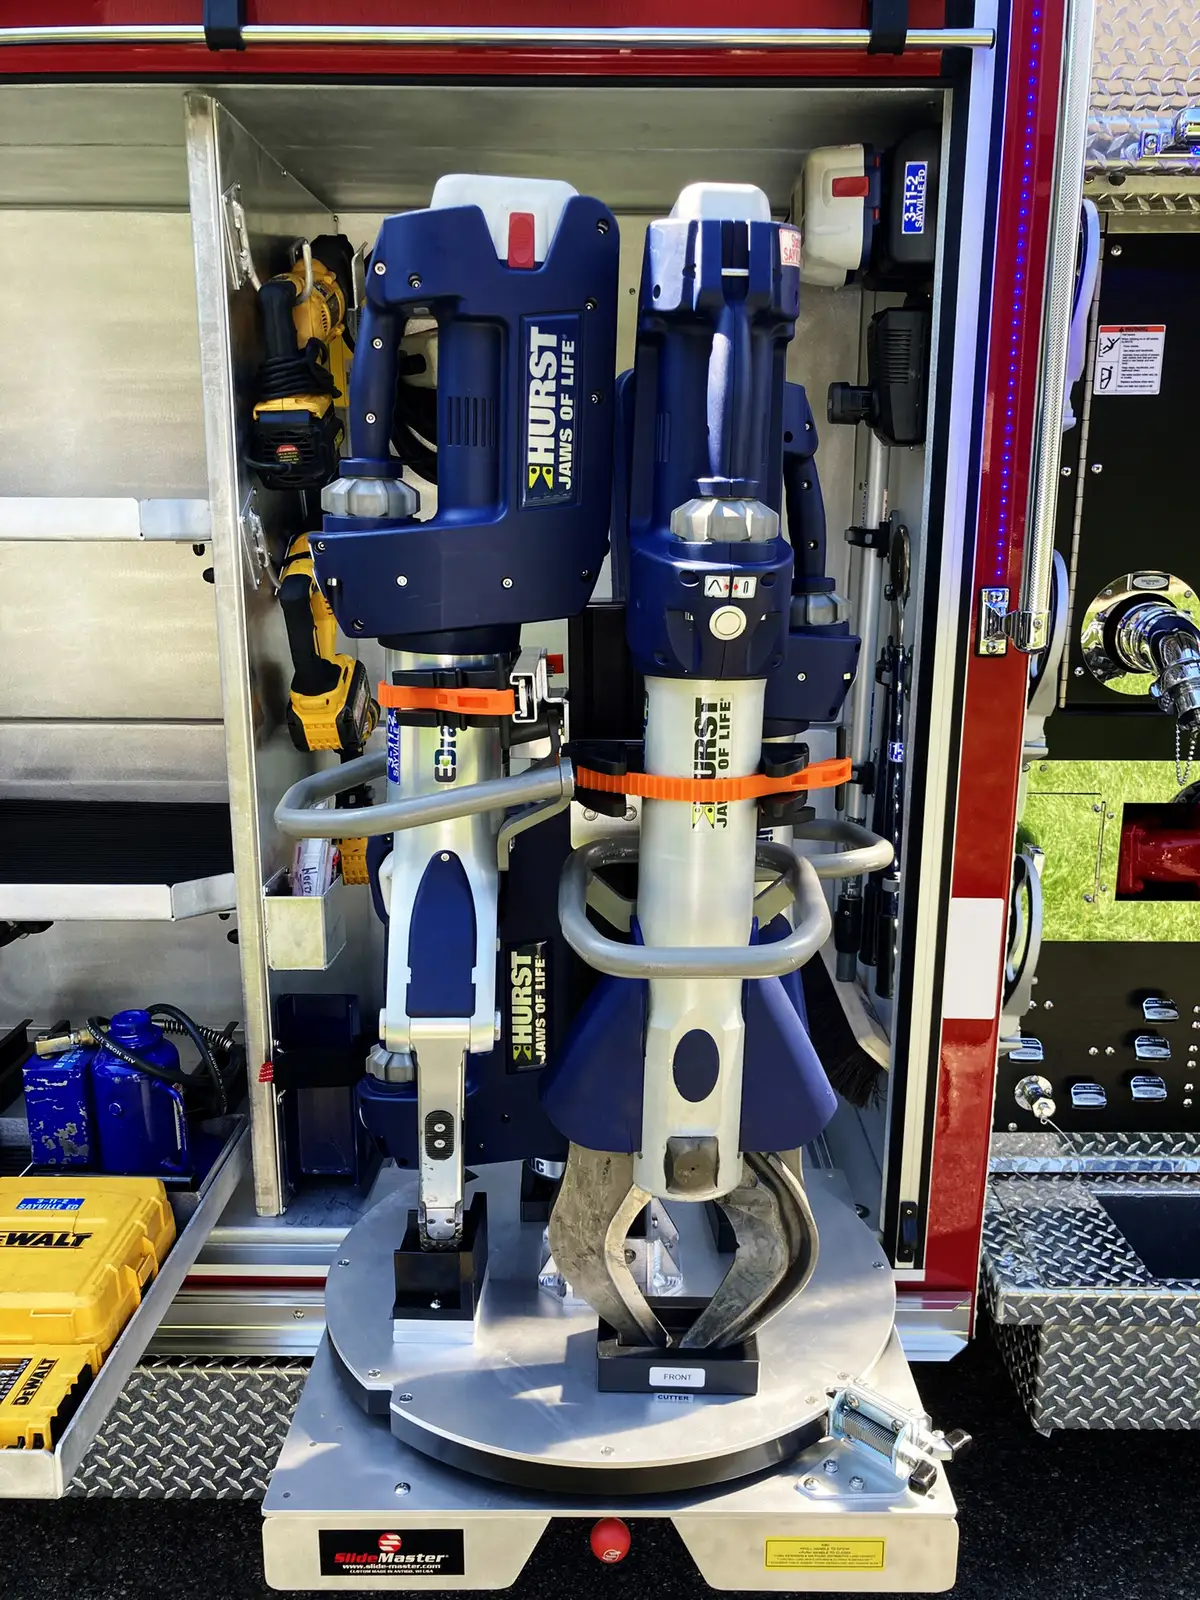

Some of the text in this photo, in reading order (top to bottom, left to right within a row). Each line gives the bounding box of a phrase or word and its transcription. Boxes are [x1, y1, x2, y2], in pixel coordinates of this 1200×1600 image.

[904, 176, 919, 221] 3-11-2
[915, 169, 926, 228] SAYVILLE FD
[527, 326, 557, 464] HURST
[559, 393, 574, 420] OF
[558, 428, 573, 490] JAWS
[387, 714, 397, 766] 3-11-2
[718, 701, 731, 740] LIFE
[693, 697, 718, 804] URST
[717, 747, 730, 770] OF
[511, 951, 533, 1044] HURST
[534, 958, 547, 1065] JAWS OF LIFE
[663, 1373, 692, 1381] FRONT
